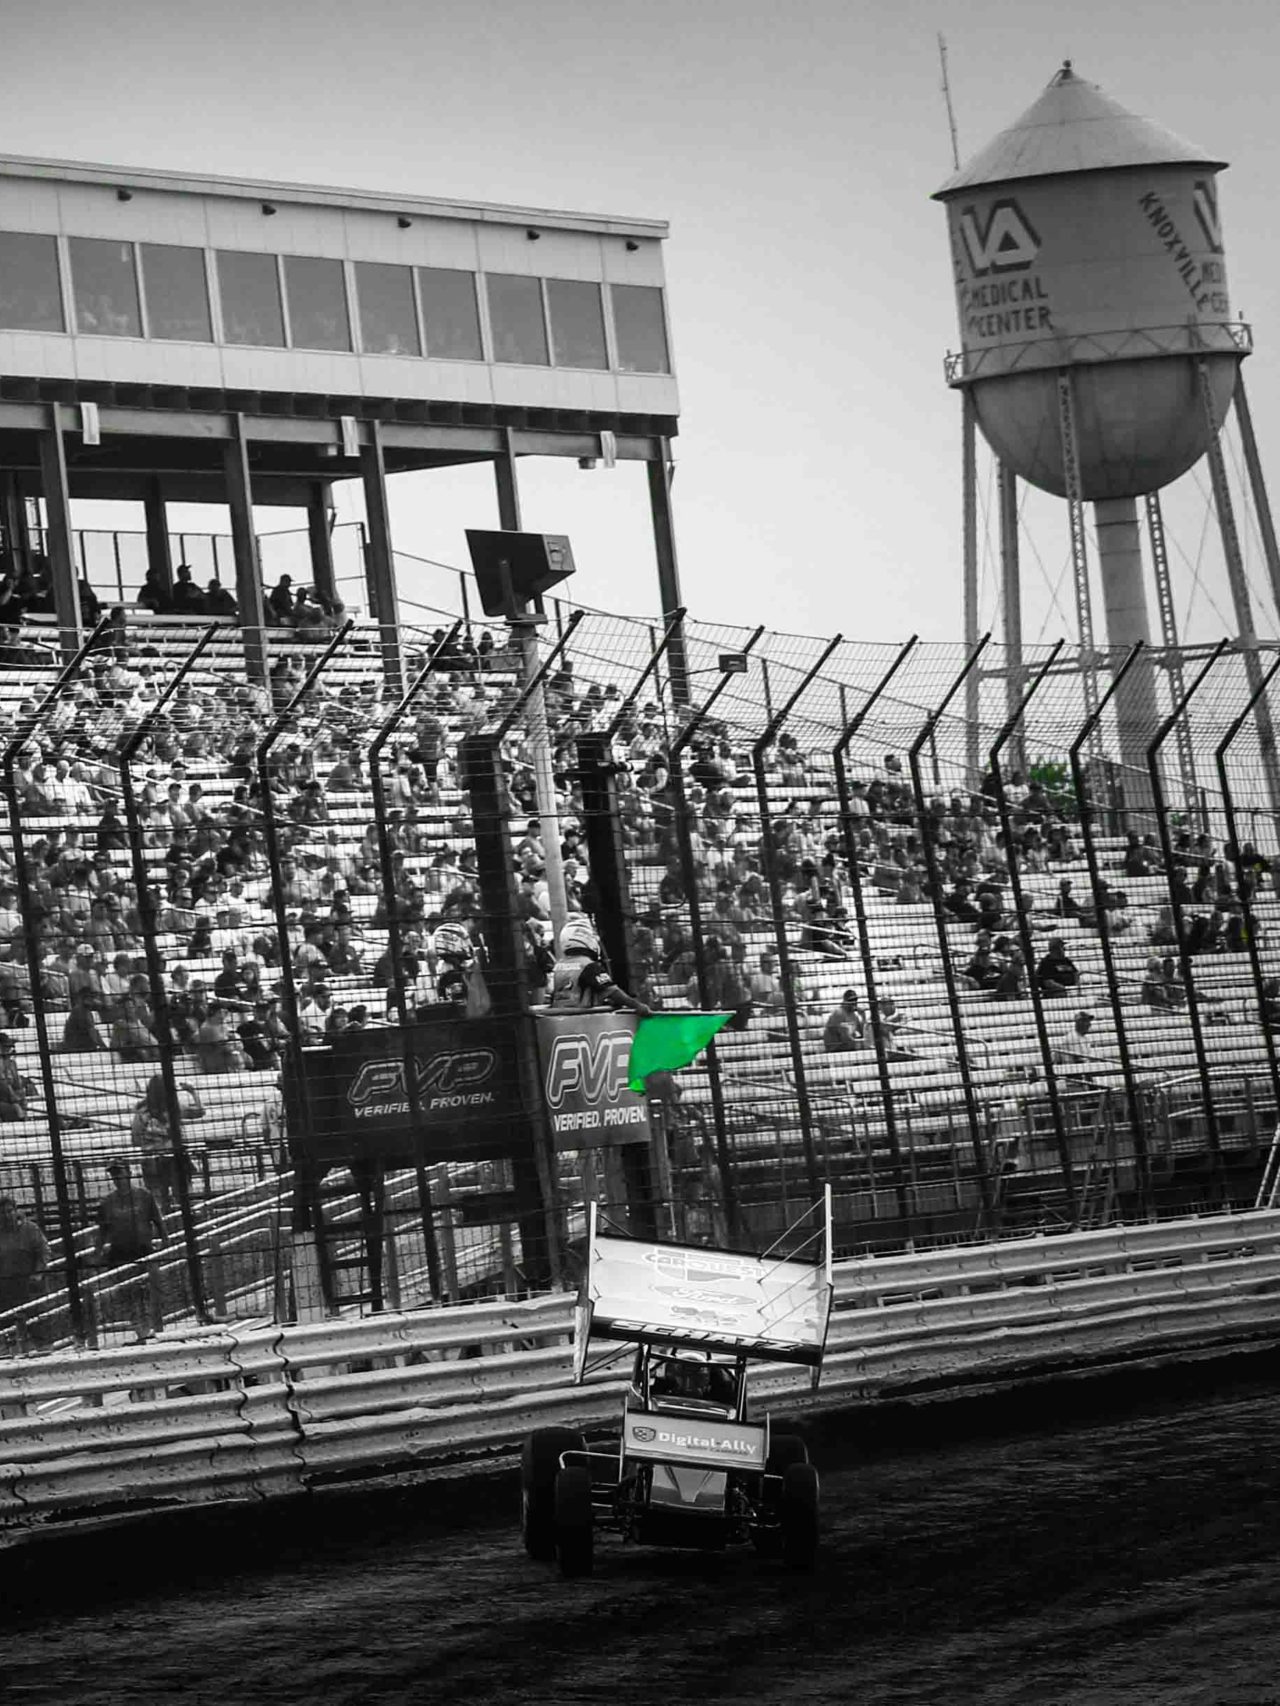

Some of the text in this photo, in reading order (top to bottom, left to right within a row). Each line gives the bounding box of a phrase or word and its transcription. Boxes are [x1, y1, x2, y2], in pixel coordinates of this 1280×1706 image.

[960, 198, 1042, 278] VA
[1139, 191, 1209, 312] KNOXVILLE
[971, 277, 1048, 307] MEDICAL
[978, 306, 1054, 337] CENTER
[355, 1092, 495, 1118] VERIFIE. PROVEN.
[554, 1111, 601, 1132] VERIFIED.
[610, 1320, 804, 1352] SCHATZ
